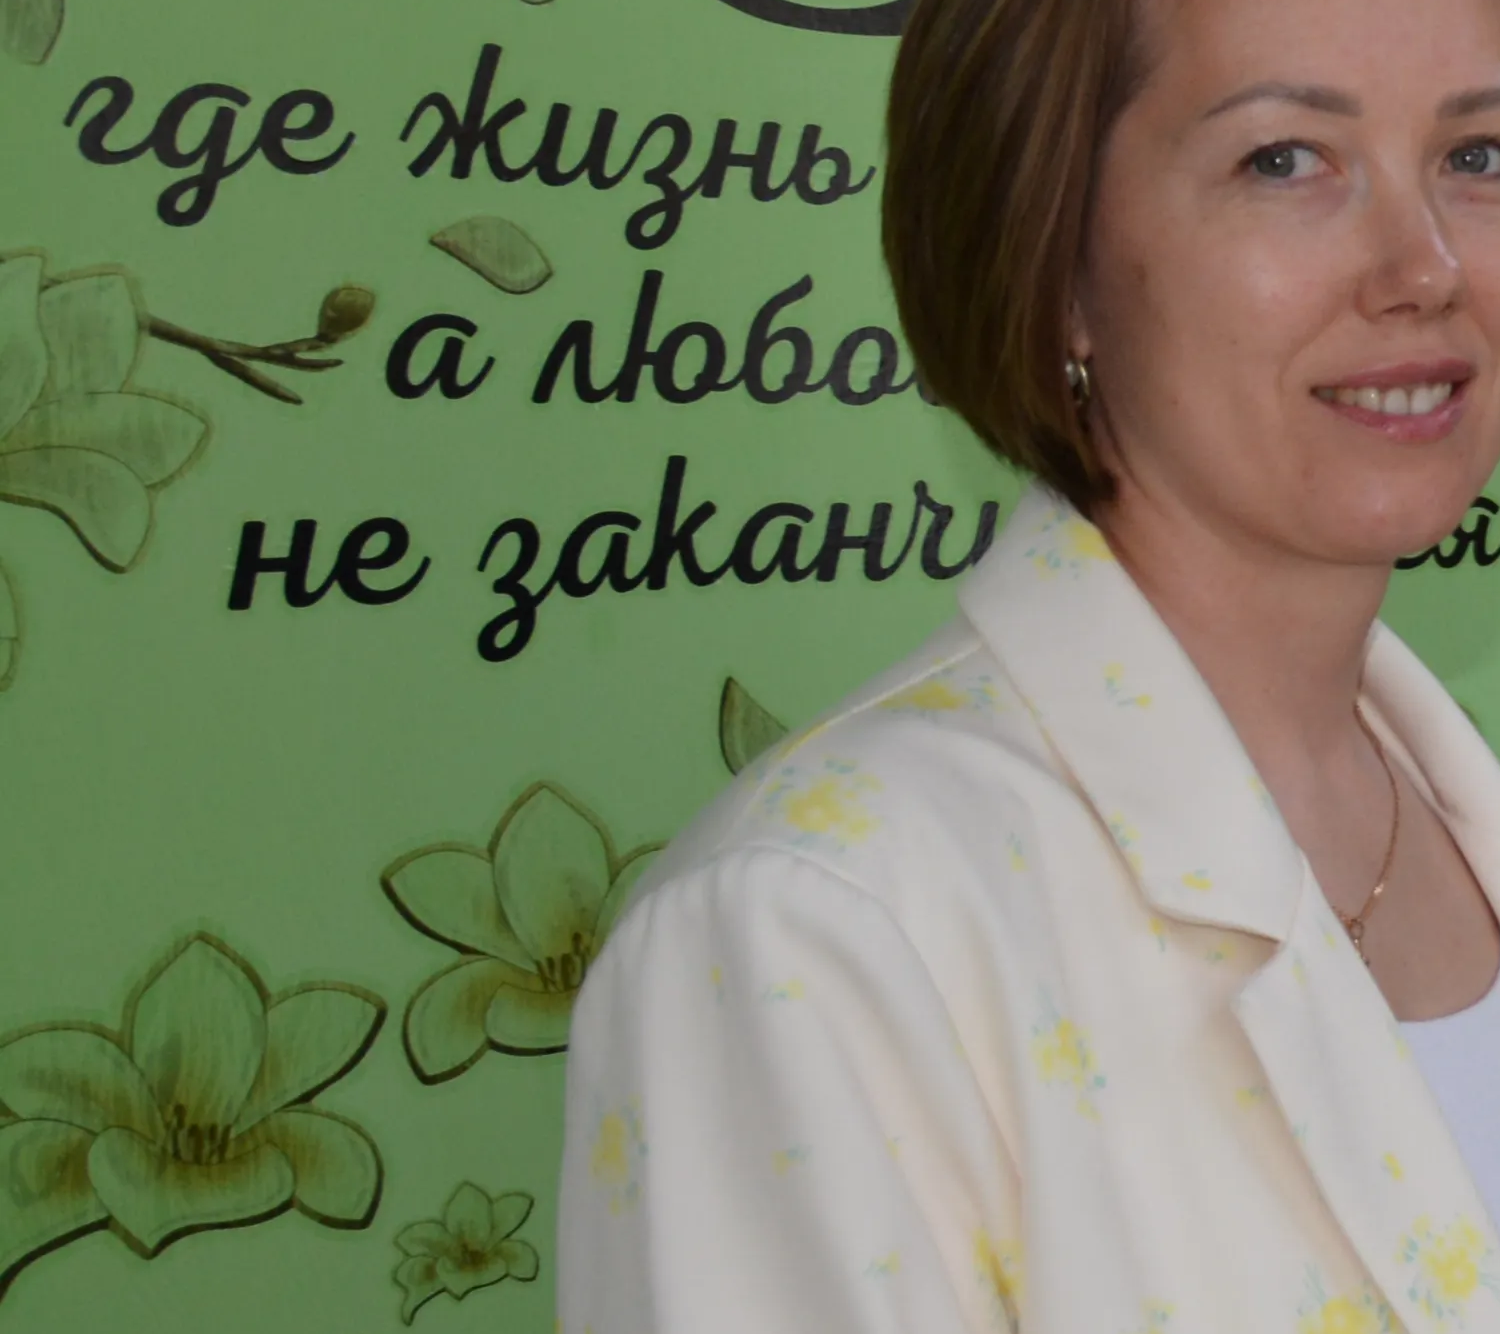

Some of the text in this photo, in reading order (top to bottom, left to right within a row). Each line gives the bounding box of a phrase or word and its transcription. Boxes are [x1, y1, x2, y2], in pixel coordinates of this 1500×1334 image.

[64, 42, 877, 250] где жизнь
[384, 268, 944, 407] а любо
[226, 514, 431, 612] не
